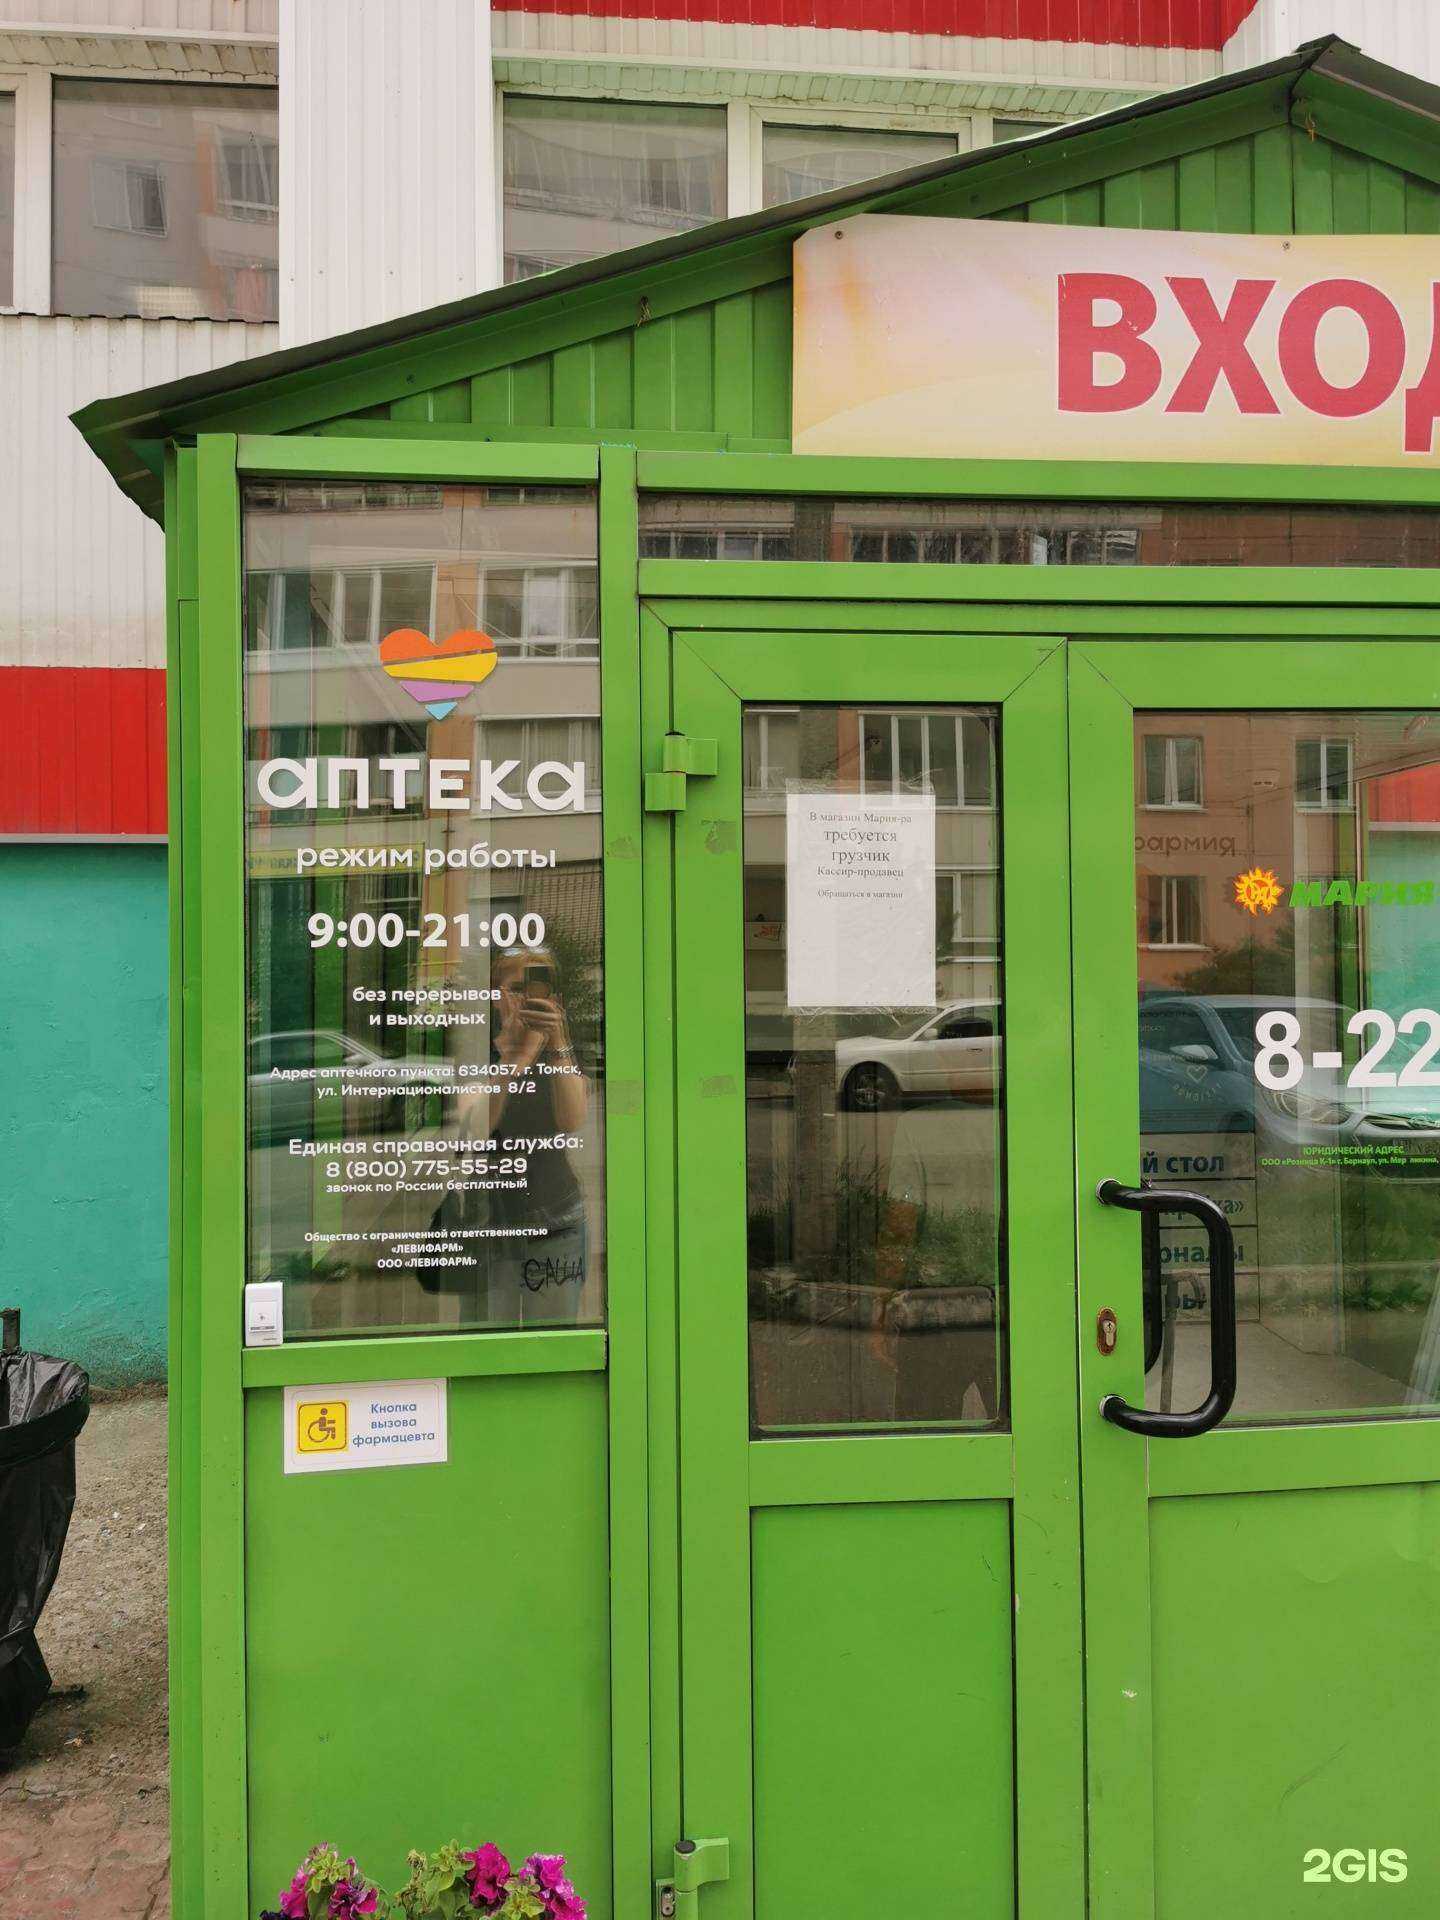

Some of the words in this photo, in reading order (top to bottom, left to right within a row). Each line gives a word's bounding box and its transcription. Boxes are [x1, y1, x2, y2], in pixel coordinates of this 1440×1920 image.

[1057, 272, 1440, 453] ВХО
[809, 812, 817, 821] В
[820, 813, 861, 822] магазин
[863, 812, 912, 825] Мария-ра
[823, 828, 898, 845] требуется
[296, 846, 413, 875] режим
[424, 841, 556, 875] работы
[832, 850, 891, 864] грузчик
[816, 866, 904, 880] Кассир-продавец
[307, 913, 546, 948] 9:00-21:00
[352, 987, 387, 1002] без
[391, 988, 501, 1005] перерывов
[369, 1014, 382, 1026] и
[386, 1012, 486, 1027] выходных
[1254, 1008, 1440, 1091] 8-22
[270, 1066, 317, 1080] Адрес
[320, 1067, 397, 1080] аптечного
[400, 1065, 455, 1079] пункта:
[458, 1065, 521, 1078] 634057,
[523, 1066, 533, 1076] г.
[536, 1063, 583, 1077] Томск,
[317, 1086, 338, 1099] ул.
[341, 1082, 501, 1097] Интернационалистов
[507, 1081, 536, 1095] 8/2
[288, 1138, 367, 1156] Единая
[372, 1138, 498, 1155] справочная
[502, 1134, 584, 1153] служба:
[1303, 1145, 1373, 1156] ЮРИДИЧЕСКИЙ
[1375, 1145, 1405, 1155] АДРЕС
[326, 1162, 341, 1178] 8
[345, 1160, 407, 1180] (800)
[411, 1157, 528, 1176] 775-55-29
[1166, 1156, 1225, 1173] стол
[1261, 1158, 1281, 1166] ООО
[326, 1182, 373, 1193] звонок
[375, 1182, 392, 1192] по
[395, 1180, 444, 1191] России
[446, 1177, 528, 1191] бесплатный
[304, 1231, 360, 1242] Общество
[370, 1228, 448, 1241] ограниченной
[449, 1226, 549, 1238] ответственностью
[391, 1242, 464, 1254] «ЛЕВИФАРМ»
[377, 1258, 403, 1269] ООО
[404, 1256, 478, 1268] «ЛЕВИФАРМ»
[370, 1402, 418, 1414] Кнопка
[370, 1417, 417, 1429] вызова
[352, 1431, 436, 1448] фармацевта
